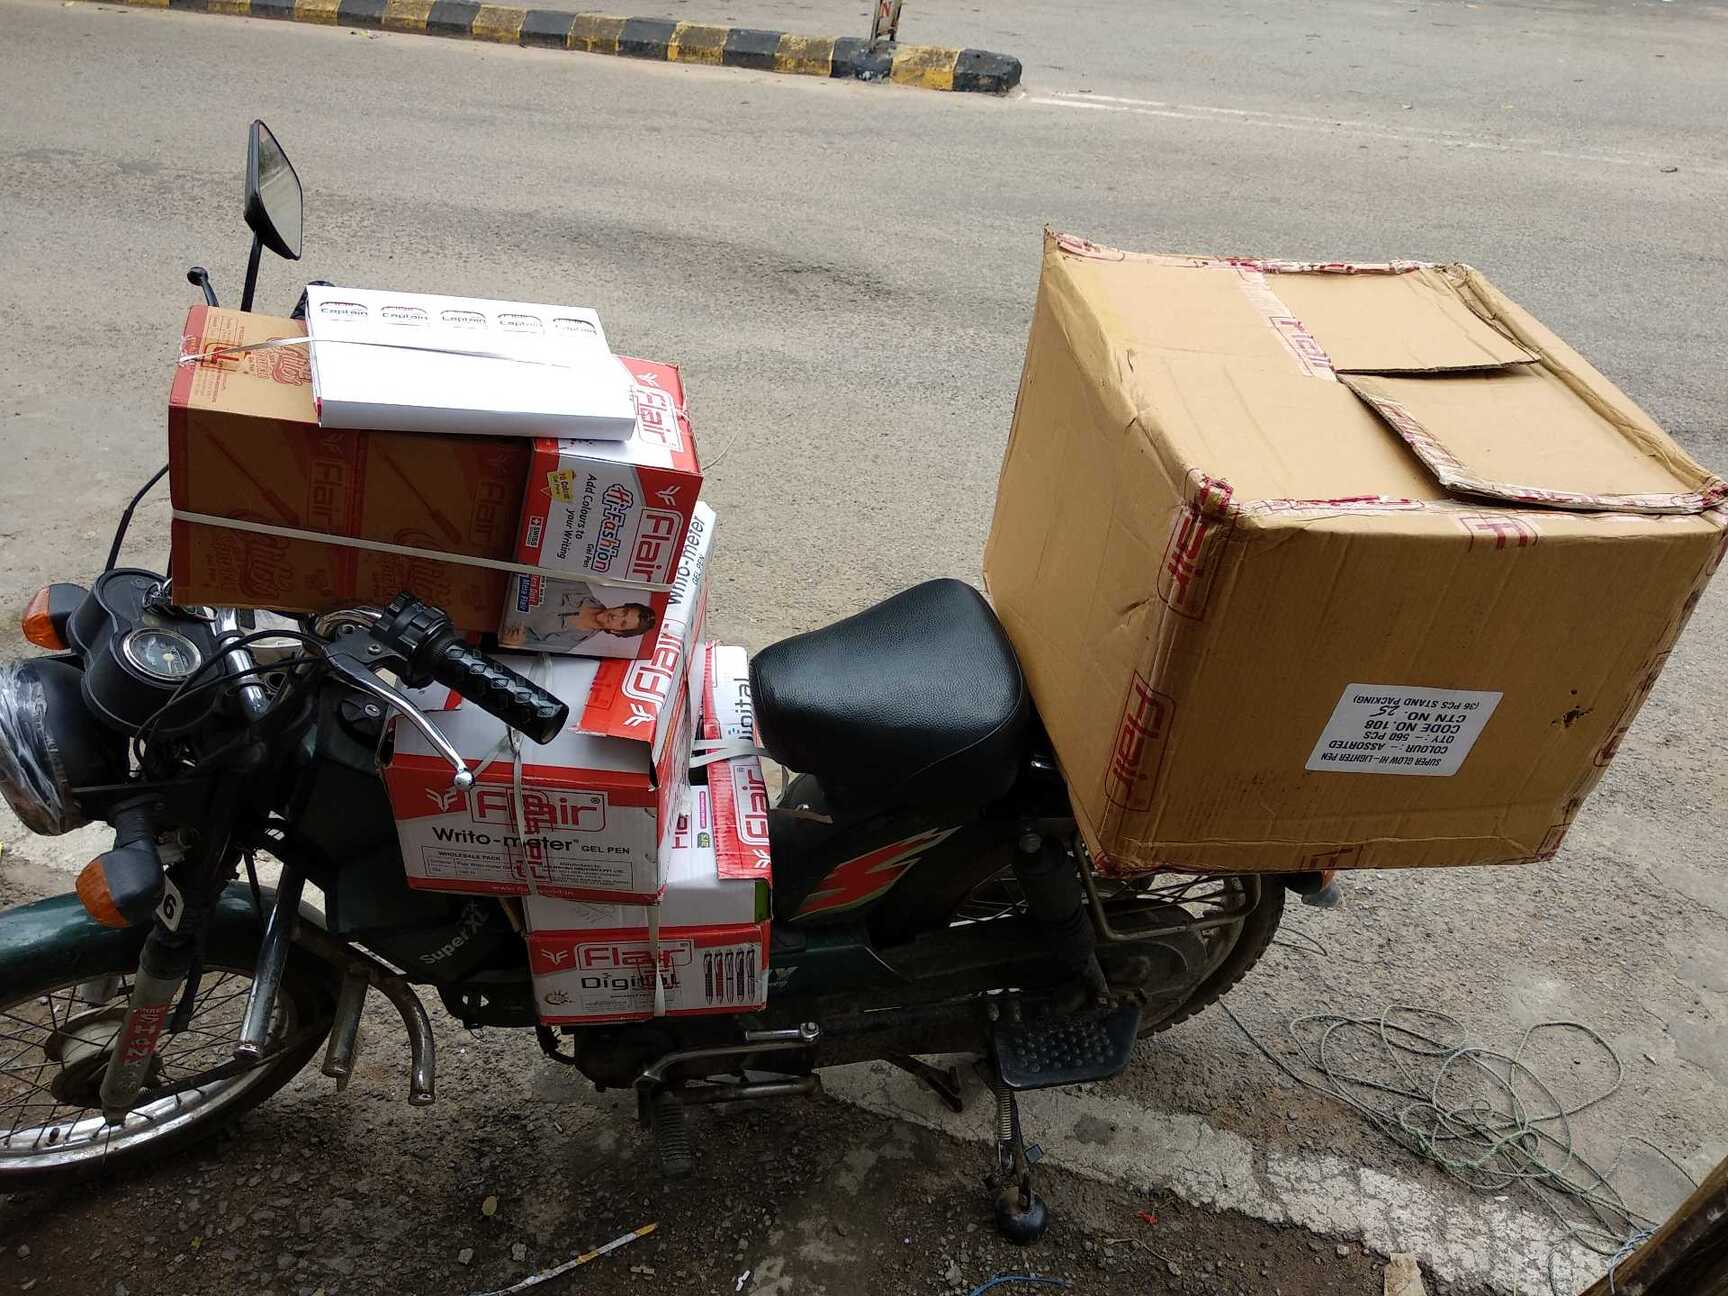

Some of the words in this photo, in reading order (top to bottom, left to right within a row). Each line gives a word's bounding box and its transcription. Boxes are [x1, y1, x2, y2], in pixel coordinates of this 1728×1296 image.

[320, 306, 369, 319] Captain
[381, 311, 430, 322] Captain
[636, 387, 671, 444] Flair
[584, 473, 598, 495] Add
[311, 463, 345, 531] Flair
[476, 483, 507, 546] Flair
[579, 495, 593, 529] Colours
[564, 508, 576, 532] your
[557, 529, 573, 559] Writing
[632, 514, 676, 582] Flair
[632, 624, 683, 698] Flair
[1353, 693, 1400, 706] PACKING)
[1403, 697, 1438, 709] STAND
[1440, 700, 1461, 710] PCS
[1404, 710, 1431, 722] NO.
[1434, 712, 1467, 723] CTN
[1364, 719, 1391, 730] 108
[1392, 722, 1417, 732] NO.
[1423, 724, 1461, 734] CODE
[1363, 731, 1386, 740] PCS
[1389, 732, 1410, 742] 560
[1433, 735, 1455, 744] QTY
[1328, 739, 1386, 752] ASSORTED
[1405, 744, 1449, 755] COLOUR
[1320, 751, 1337, 761] PEN
[1389, 755, 1414, 766] GLOW
[1414, 757, 1442, 767] SUPER
[478, 787, 598, 827] Flair
[741, 768, 765, 838] Flair
[671, 812, 690, 848] Fla
[432, 826, 574, 851] Writo-meter
[581, 845, 603, 854] GEL
[606, 846, 631, 855] PEN
[419, 931, 469, 964] Super
